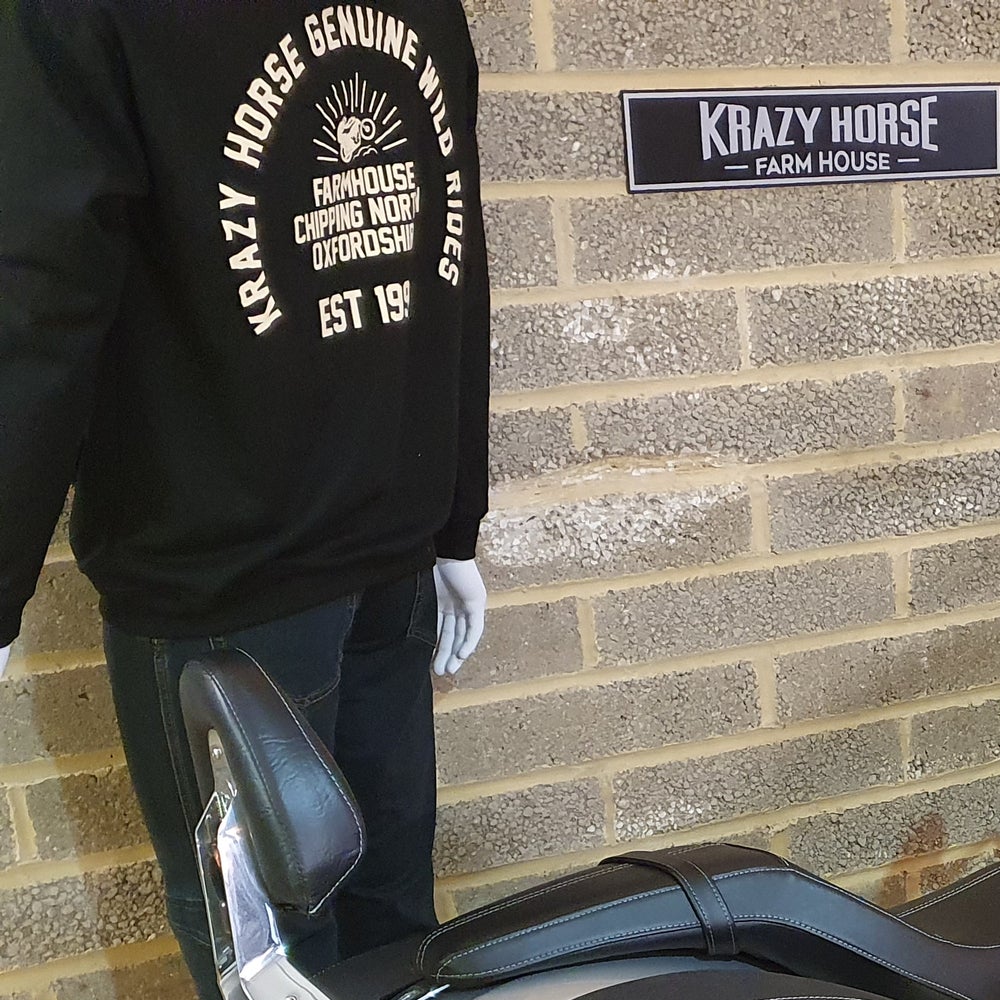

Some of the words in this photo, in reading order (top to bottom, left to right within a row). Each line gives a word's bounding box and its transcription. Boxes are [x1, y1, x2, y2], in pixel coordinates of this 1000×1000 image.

[304, 5, 419, 71] GENUINE
[223, 33, 306, 169] HORSE
[417, 55, 454, 157] WILD
[699, 101, 822, 160] KRAZY
[830, 95, 939, 152] HORSE
[312, 161, 416, 207] FARMHOUSE
[755, 154, 812, 176] FARM
[818, 151, 891, 173] HOUSE
[294, 200, 364, 245] CHIPPING
[438, 169, 463, 286] RIDES
[218, 182, 283, 336] KRAZY
[318, 288, 363, 338] EST
